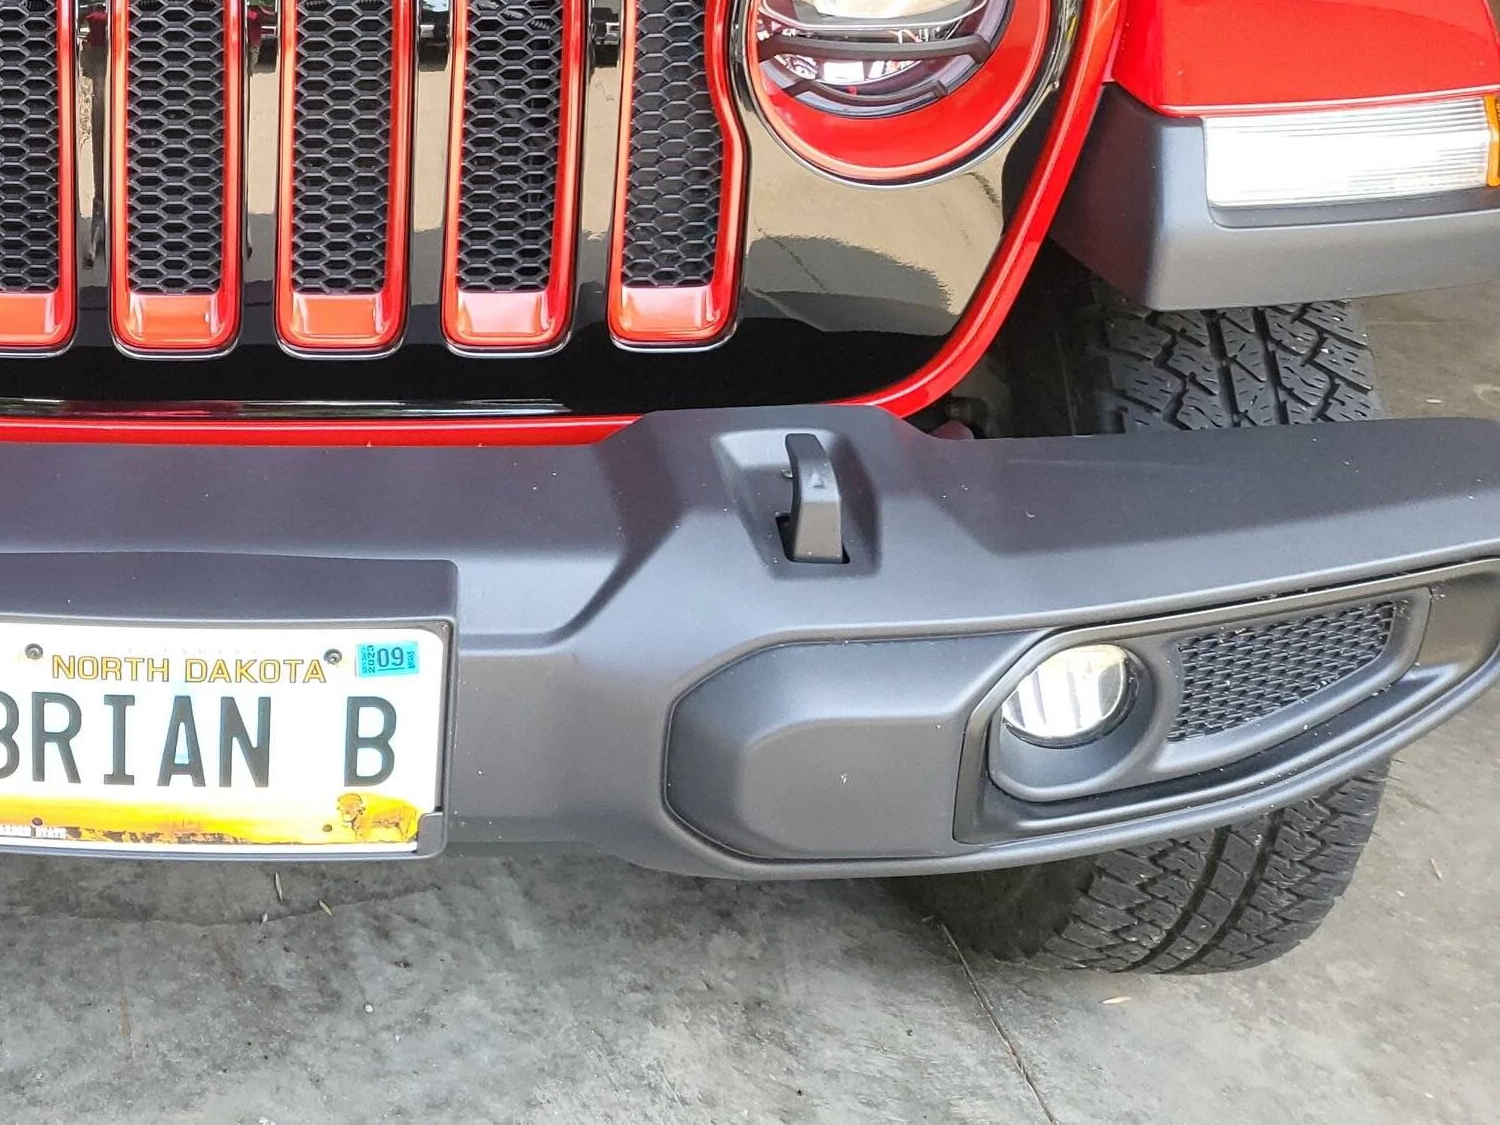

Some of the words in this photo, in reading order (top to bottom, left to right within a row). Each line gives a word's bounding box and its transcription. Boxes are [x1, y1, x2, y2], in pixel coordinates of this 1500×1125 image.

[52, 654, 171, 683] NORTH
[185, 655, 327, 684] DAKOTA
[367, 645, 376, 673] 2023
[377, 647, 404, 668] 09
[343, 696, 397, 788] B
